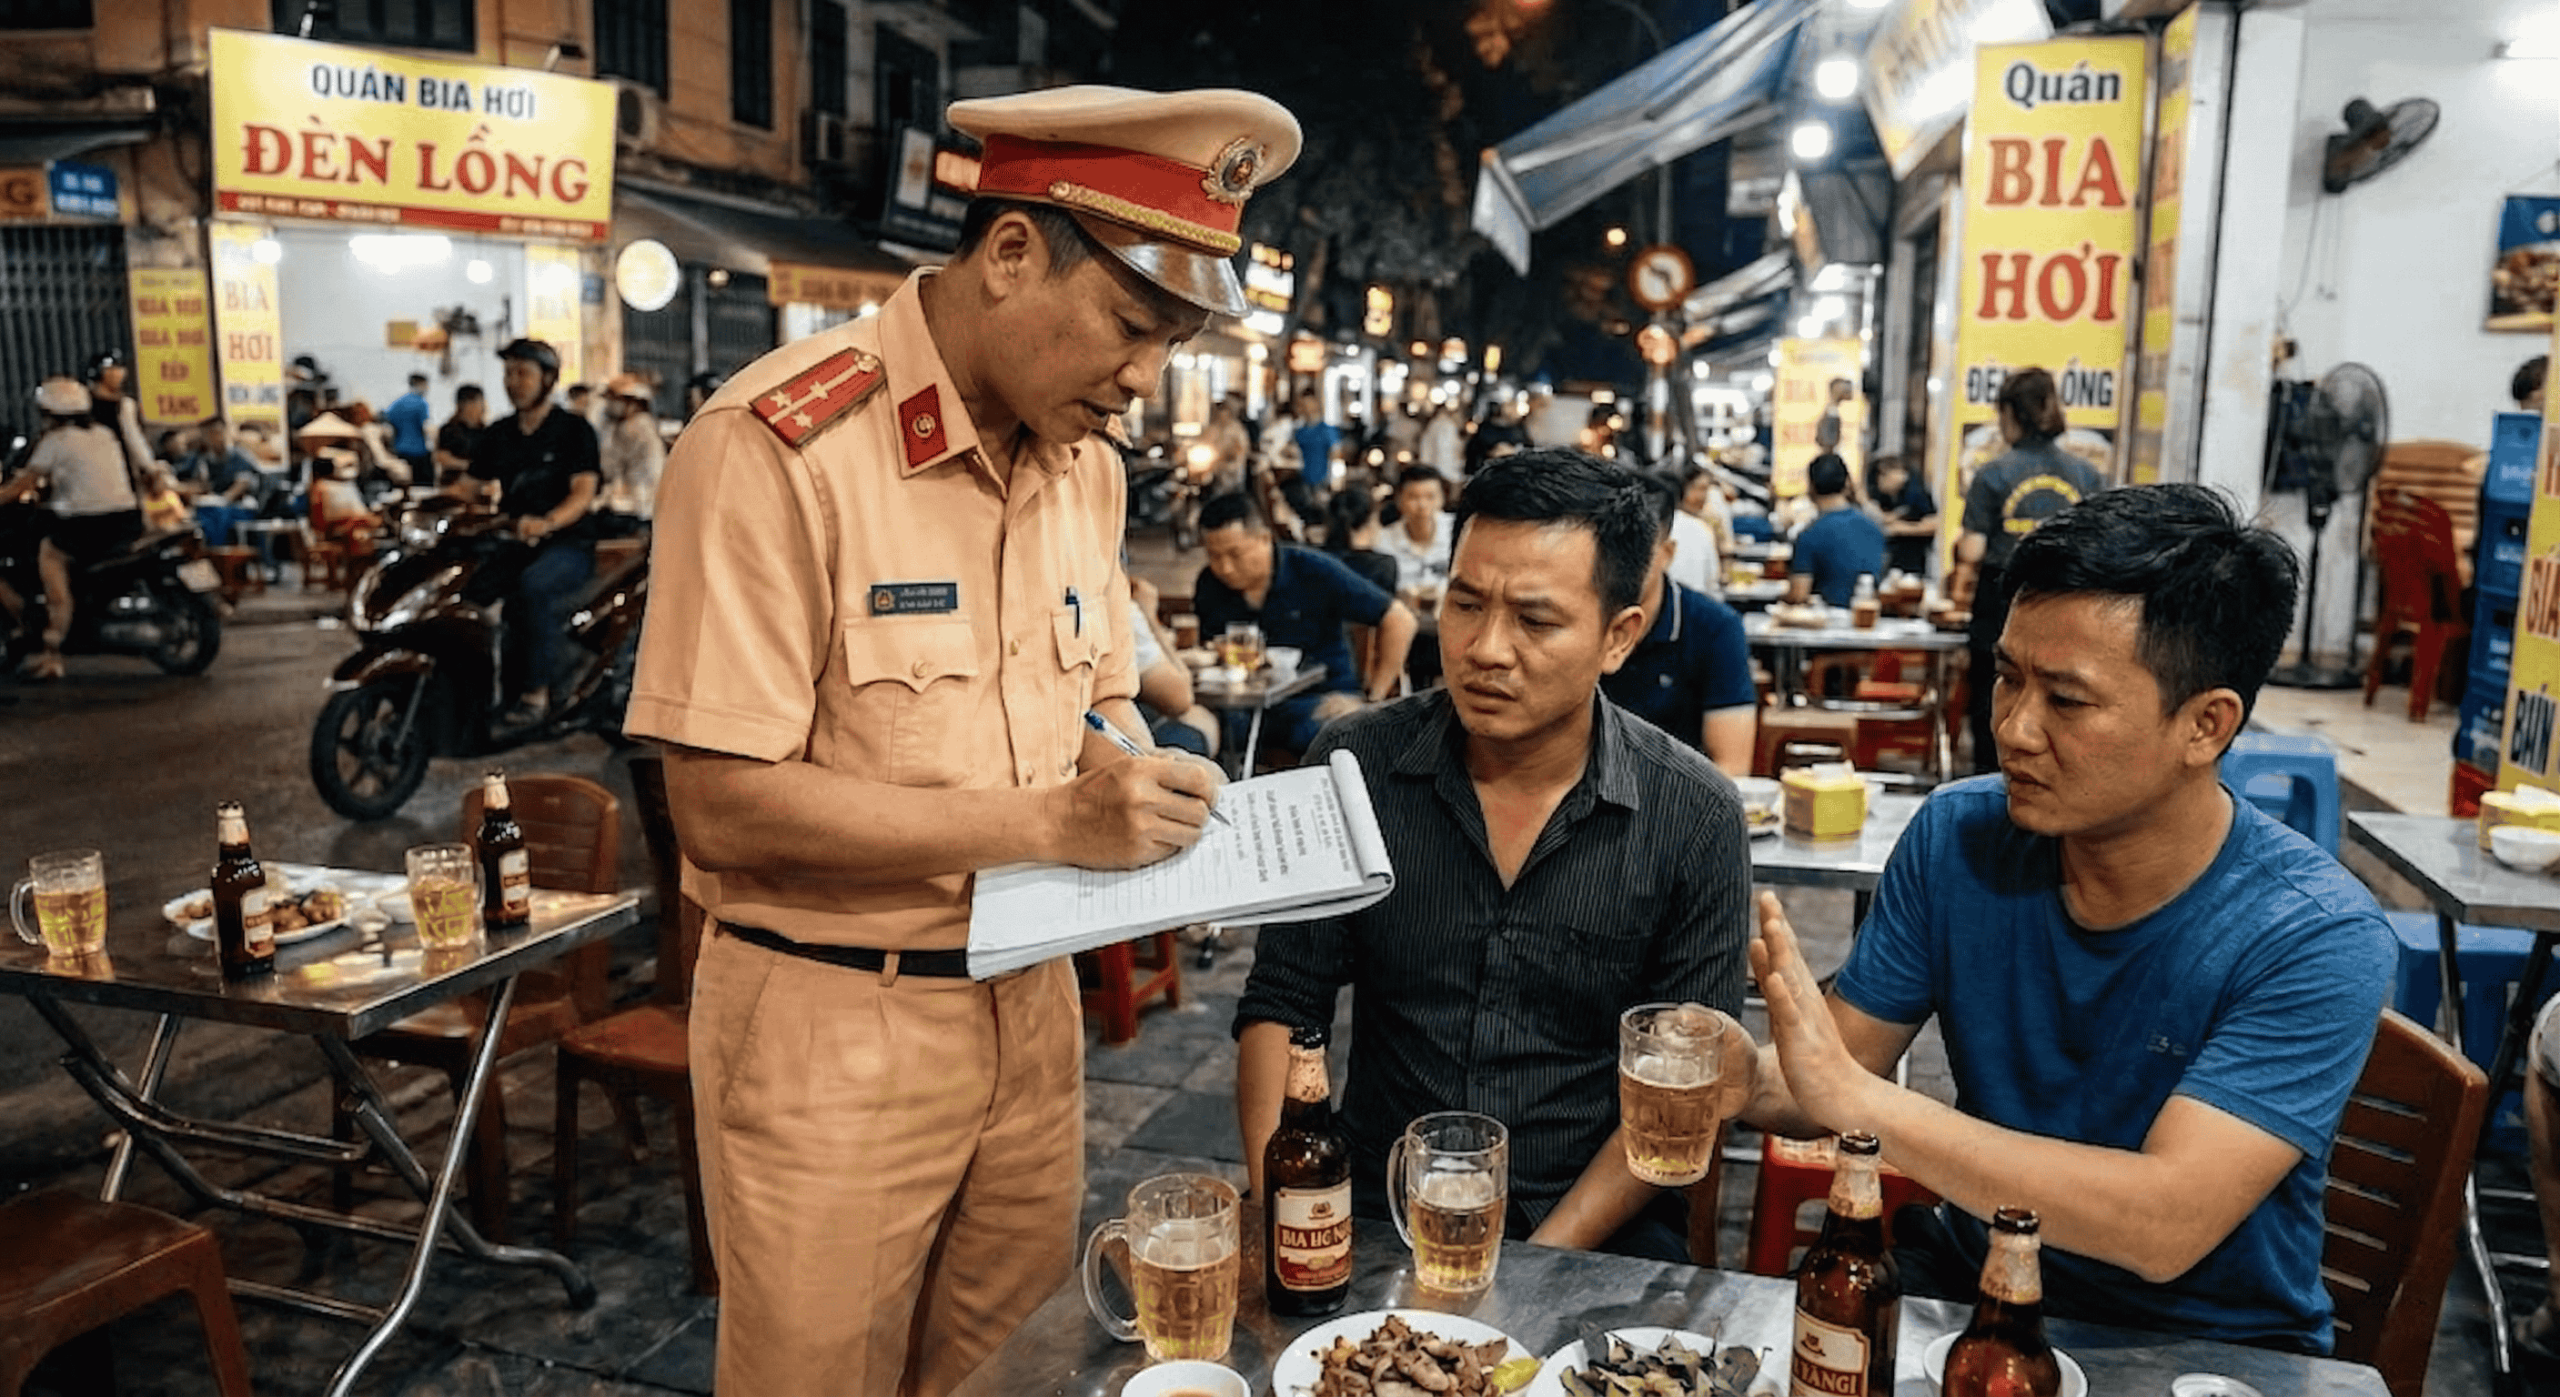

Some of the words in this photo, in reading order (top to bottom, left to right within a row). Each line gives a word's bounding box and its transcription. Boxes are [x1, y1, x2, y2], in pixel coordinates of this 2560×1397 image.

[312, 63, 405, 103] QUÁN
[418, 77, 472, 112] BIA
[483, 86, 536, 119] HƠI
[2006, 60, 2120, 110] Quán
[241, 114, 394, 185] ĐÈN
[416, 122, 589, 203] LỒNG
[1985, 138, 2126, 207] BIA
[224, 279, 271, 311] BIA
[1977, 241, 2123, 321] HƠI
[228, 331, 274, 362] HƠI
[1281, 1228, 1308, 1248] BIA
